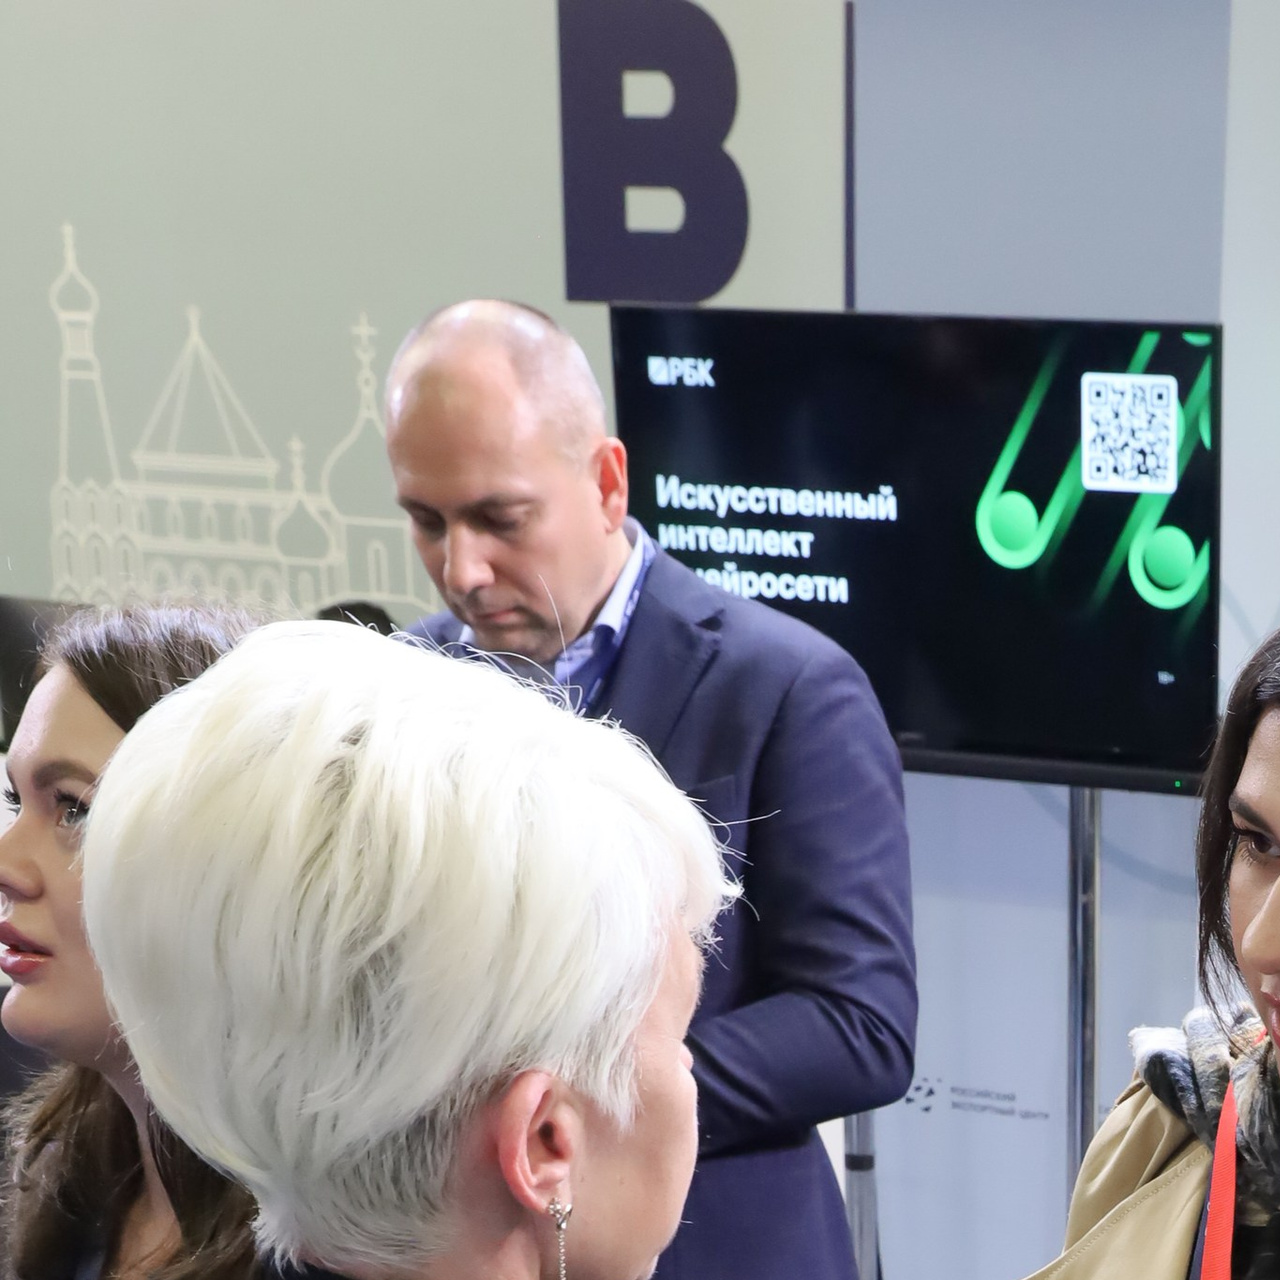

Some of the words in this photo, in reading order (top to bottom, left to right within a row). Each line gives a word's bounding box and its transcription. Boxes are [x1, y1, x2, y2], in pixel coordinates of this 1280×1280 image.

[668, 357, 716, 388] РБК
[655, 473, 899, 521] Искусственный
[658, 522, 815, 558] интеллект
